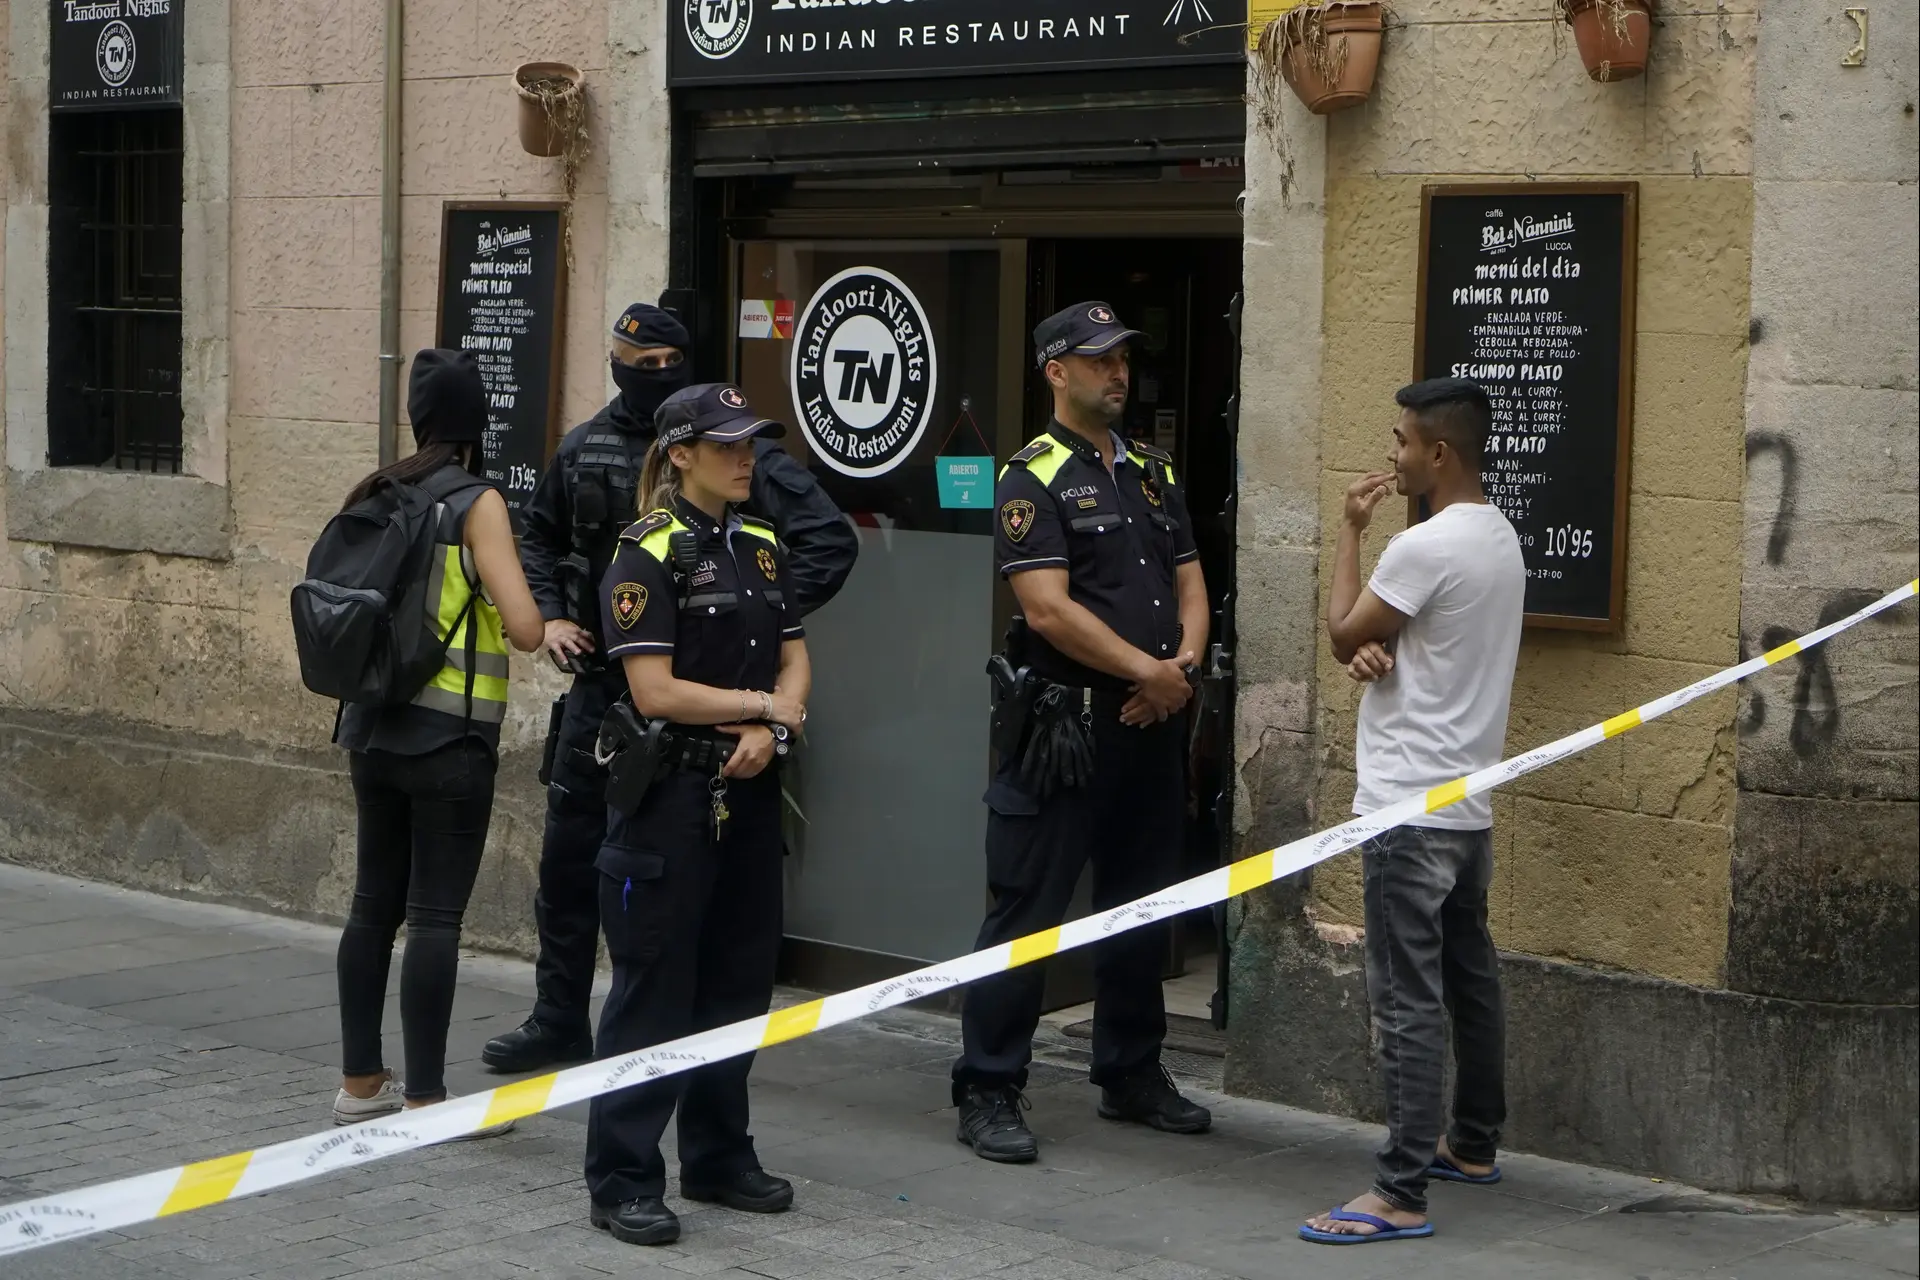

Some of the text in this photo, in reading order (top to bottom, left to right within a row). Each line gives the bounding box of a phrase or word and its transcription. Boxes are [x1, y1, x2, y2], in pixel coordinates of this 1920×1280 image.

[64, 0, 170, 22] Tandoori Nights
[706, 0, 733, 24] TN
[766, 14, 1131, 53] INDIAN RESTAURANT
[108, 46, 124, 63] TN
[62, 85, 171, 100] INDIAN RESTAURANT
[1508, 211, 1574, 248] Nannini
[1545, 242, 1572, 251] LUCCA
[470, 256, 532, 279] menú especial
[1474, 257, 1518, 280] menú
[1521, 256, 1547, 279] del
[490, 279, 512, 294] PLATO
[480, 299, 524, 307] ENSALADA VERDE
[1510, 287, 1549, 305] PLATO
[475, 316, 524, 325] CEBOLLA REBOZADA
[743, 314, 768, 322] ABIERTO
[1487, 310, 1563, 323] ENSALADA VERDE
[801, 284, 922, 383] Tandoori Nights
[1533, 325, 1543, 335] DE
[1545, 325, 1583, 336] VERDURA
[461, 335, 513, 352] SEGUNDO PLATO
[1479, 336, 1569, 348] CEBOLLA REBOZADA
[478, 354, 494, 363] POLLO
[1474, 348, 1576, 359] CROQUETAS DE POLLO
[832, 349, 895, 405] TN
[1451, 363, 1563, 381] SEGUNDO PLATO
[1511, 386, 1523, 397] AL
[1528, 386, 1558, 398] CURRY
[491, 393, 515, 409] PLATO
[1516, 400, 1527, 410] AL
[1531, 400, 1563, 411] CURRY
[1518, 411, 1529, 421] AL
[1533, 412, 1561, 423] CURRY
[805, 393, 917, 460] Indian Restaurant
[1517, 424, 1528, 433] AL
[1532, 423, 1561, 434] CURRY
[1506, 435, 1547, 454] PLATO
[949, 464, 979, 475] ABIERTO
[1496, 459, 1519, 471] NAN
[1060, 485, 1100, 502] POLICIA
[1492, 484, 1521, 495] ROTE
